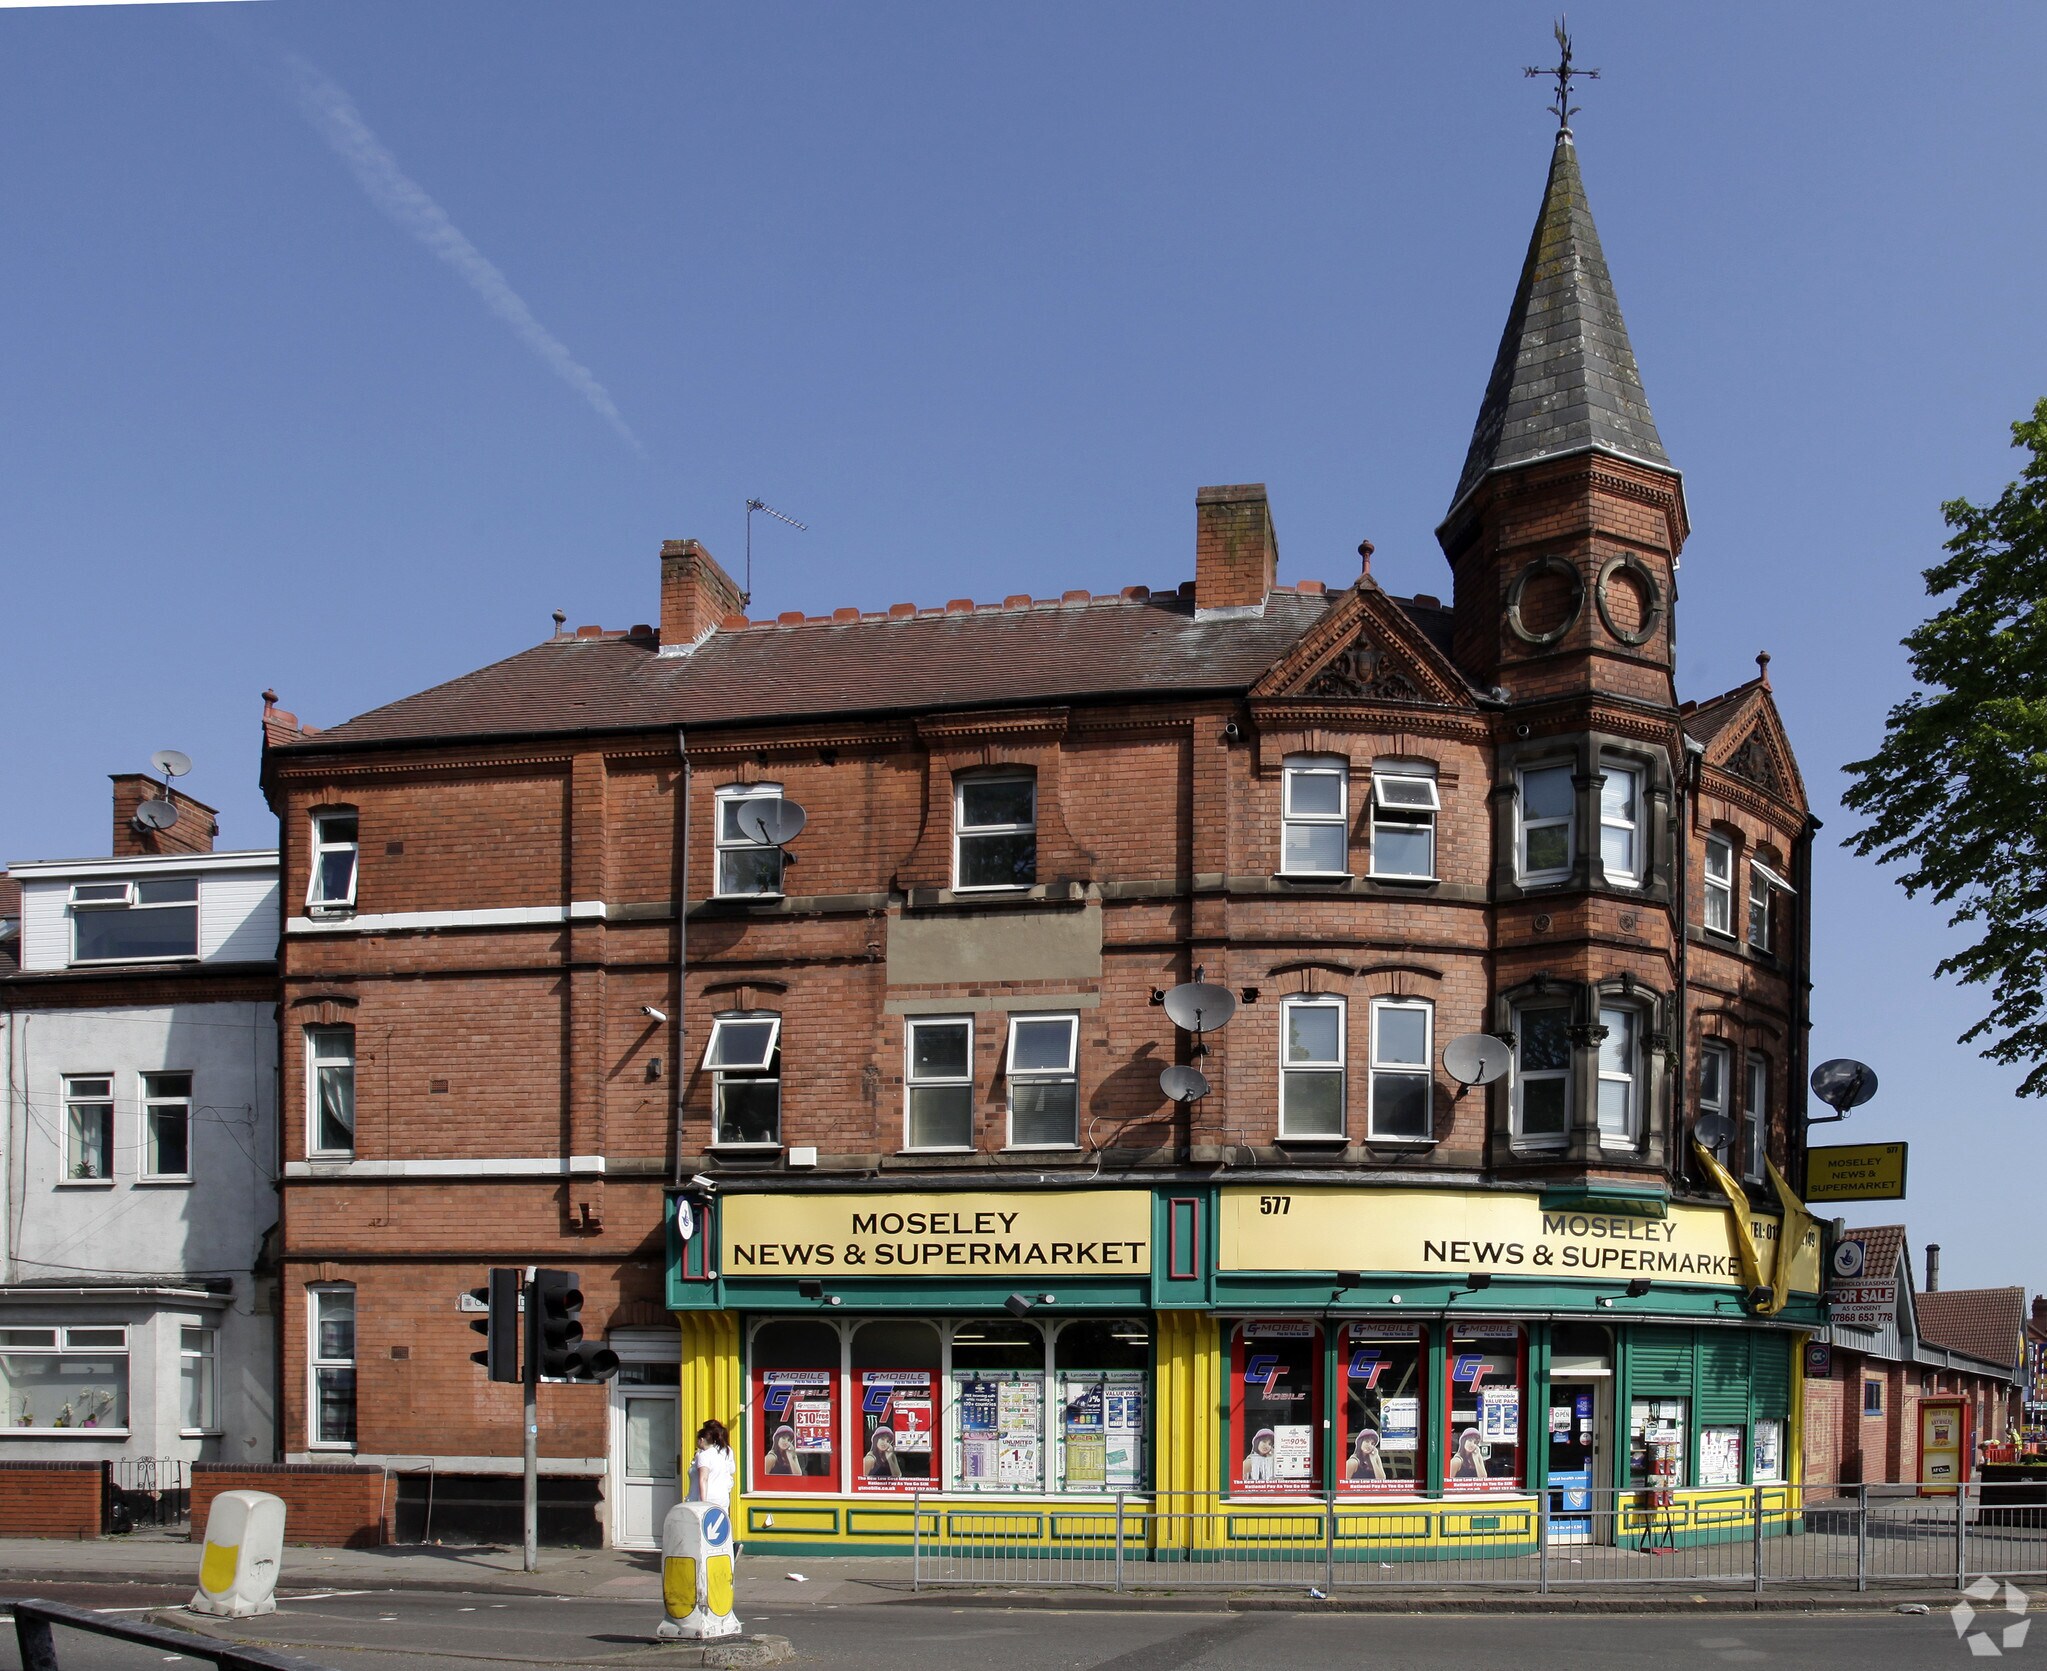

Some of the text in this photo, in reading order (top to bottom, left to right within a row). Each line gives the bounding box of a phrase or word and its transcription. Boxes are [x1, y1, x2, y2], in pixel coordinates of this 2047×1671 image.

[1886, 1146, 1898, 1154] 577
[1828, 1158, 1881, 1168] MOSELEY
[1832, 1171, 1865, 1179] NEWS
[1811, 1181, 1896, 1192] SUPERMARKET
[1260, 1196, 1291, 1215] 577
[852, 1212, 1019, 1235] MOSELEY
[1542, 1214, 1677, 1242] MOSELEY
[734, 1242, 1146, 1265] NEWS & SUPERMARKET
[1424, 1240, 1740, 1276] NEWS & SUPERMARKE
[1861, 1289, 1893, 1302] SALE
[1878, 1313, 1893, 1321] 778
[797, 1413, 815, 1424] £10
